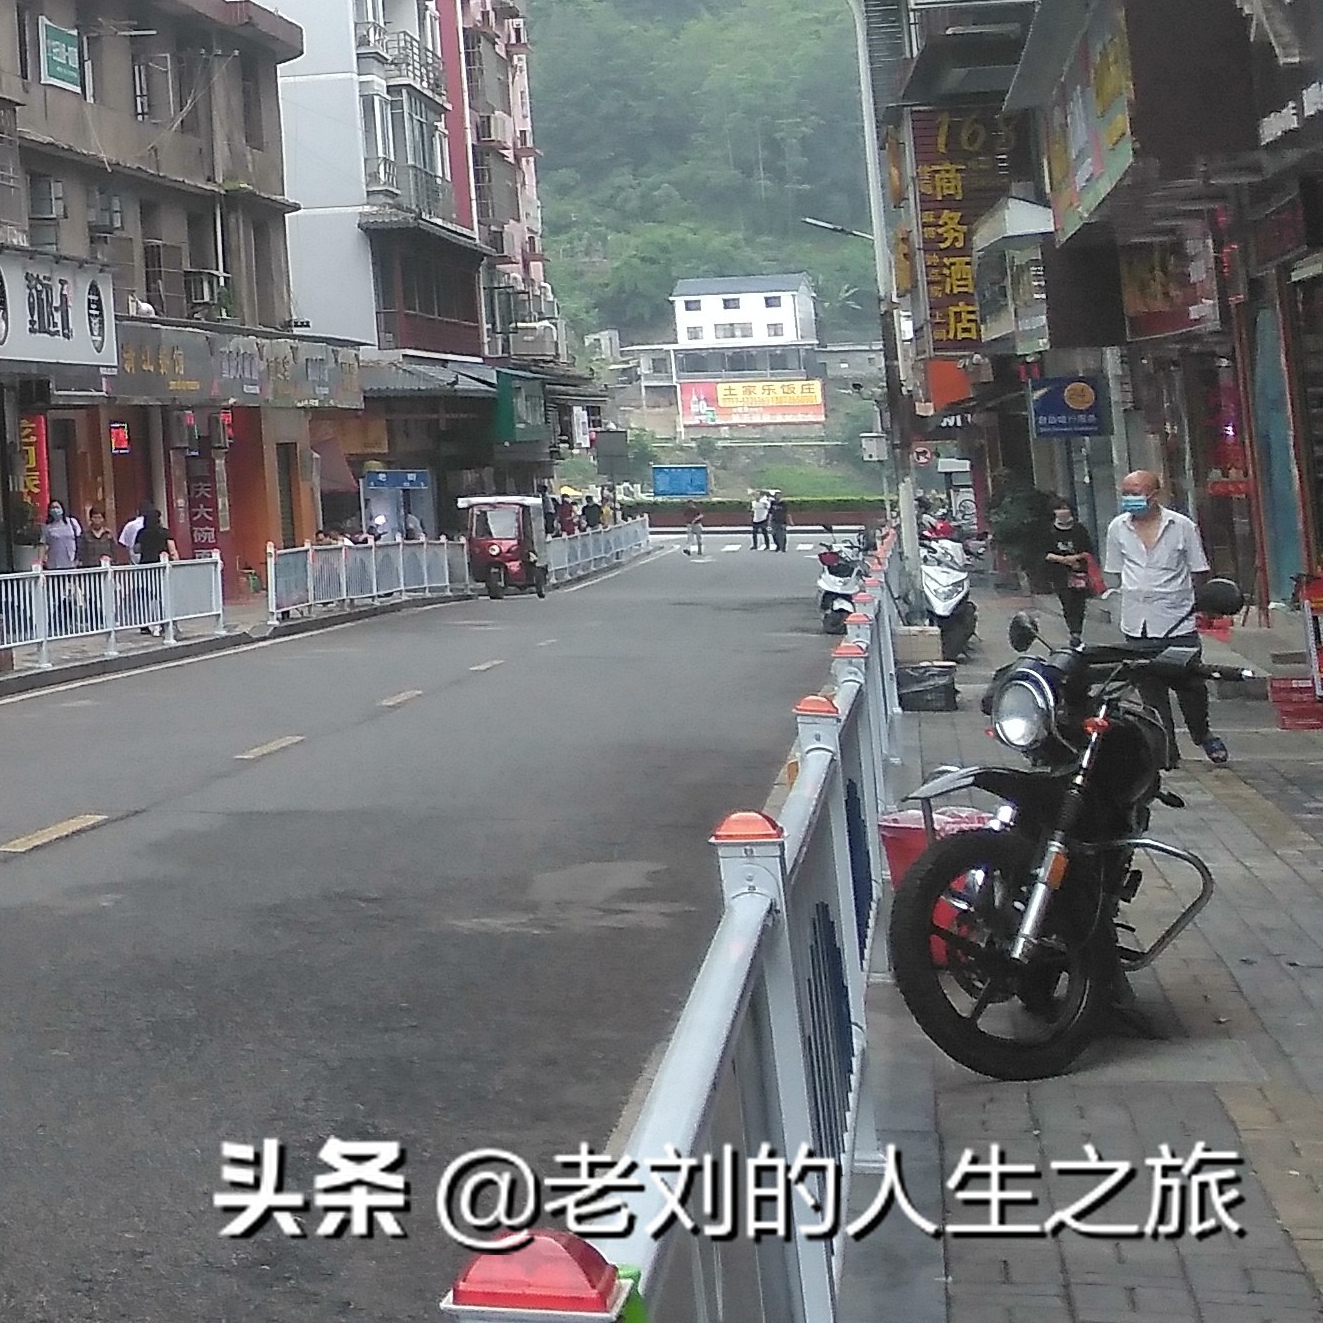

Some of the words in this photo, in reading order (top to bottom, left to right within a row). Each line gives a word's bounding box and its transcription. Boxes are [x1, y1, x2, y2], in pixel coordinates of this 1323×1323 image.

[931, 163, 982, 342] 商务酒店
[722, 383, 816, 396] 土家乐饭庄
